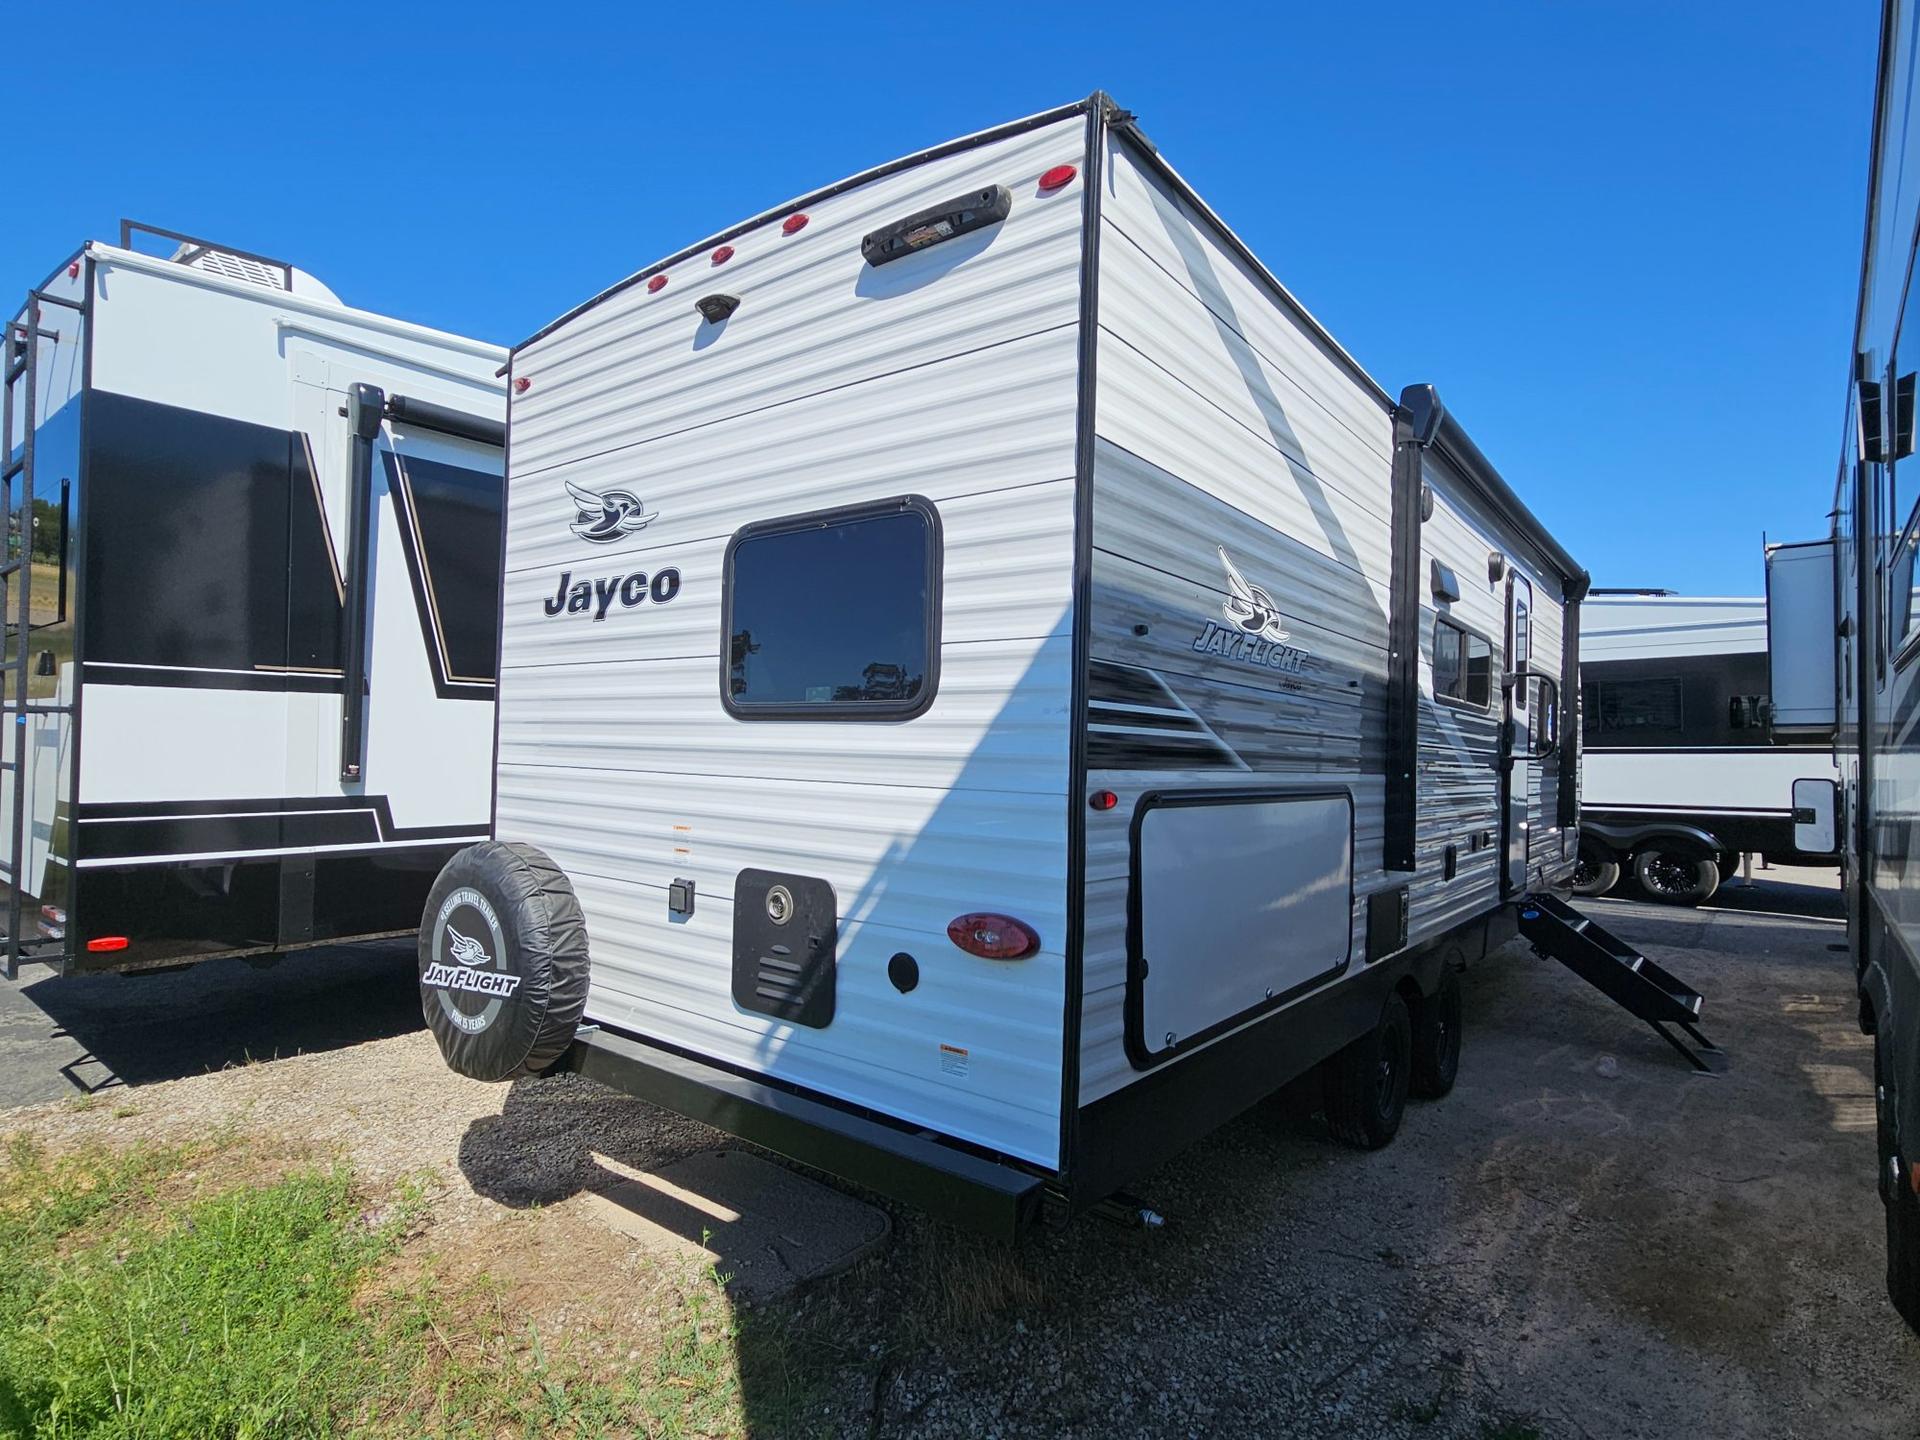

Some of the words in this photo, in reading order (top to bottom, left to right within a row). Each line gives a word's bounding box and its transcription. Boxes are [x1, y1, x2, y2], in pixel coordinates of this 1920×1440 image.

[544, 566, 682, 622] Jayco
[461, 891, 479, 906] TRAVEL
[480, 898, 498, 931] TRAILER
[452, 1009, 462, 1026] FOR
[468, 1015, 486, 1030] YEARS
